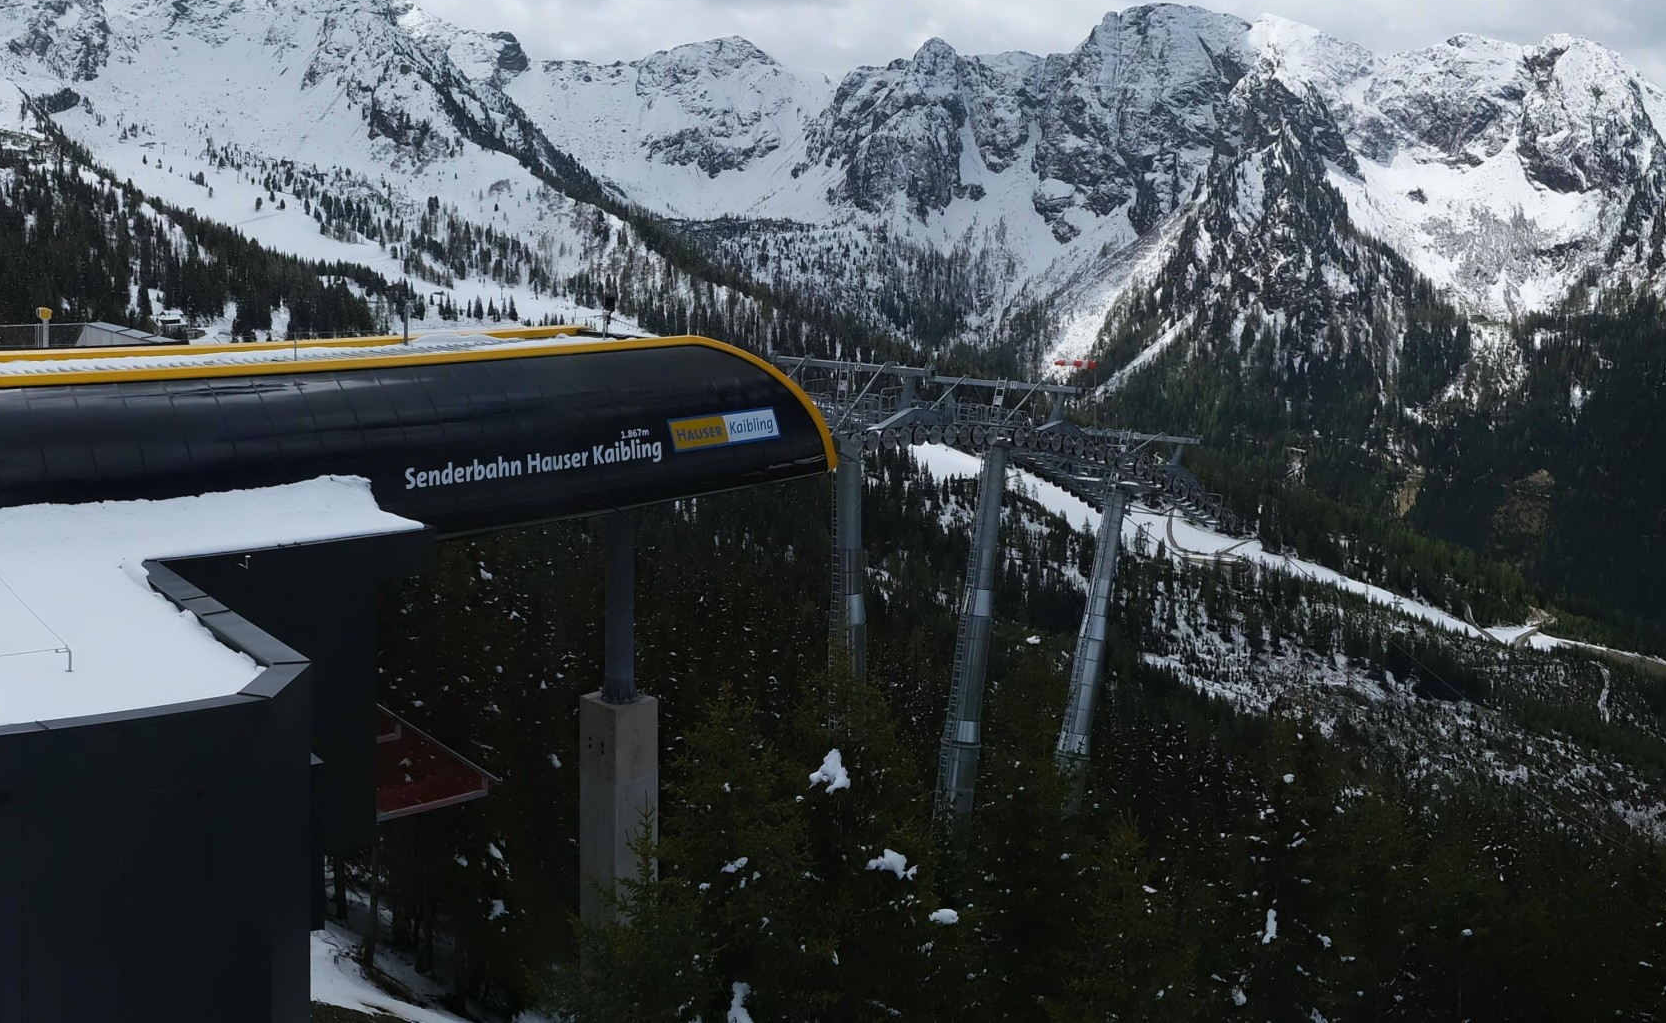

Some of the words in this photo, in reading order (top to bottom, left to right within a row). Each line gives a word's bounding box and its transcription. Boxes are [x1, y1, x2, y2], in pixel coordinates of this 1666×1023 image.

[620, 428, 650, 439] 1.867m
[676, 425, 723, 442] HAUSER
[729, 418, 774, 436] Kaibling
[405, 456, 522, 490] Senderbahn
[527, 450, 589, 474] Hauser
[592, 439, 662, 465] Kaibling
